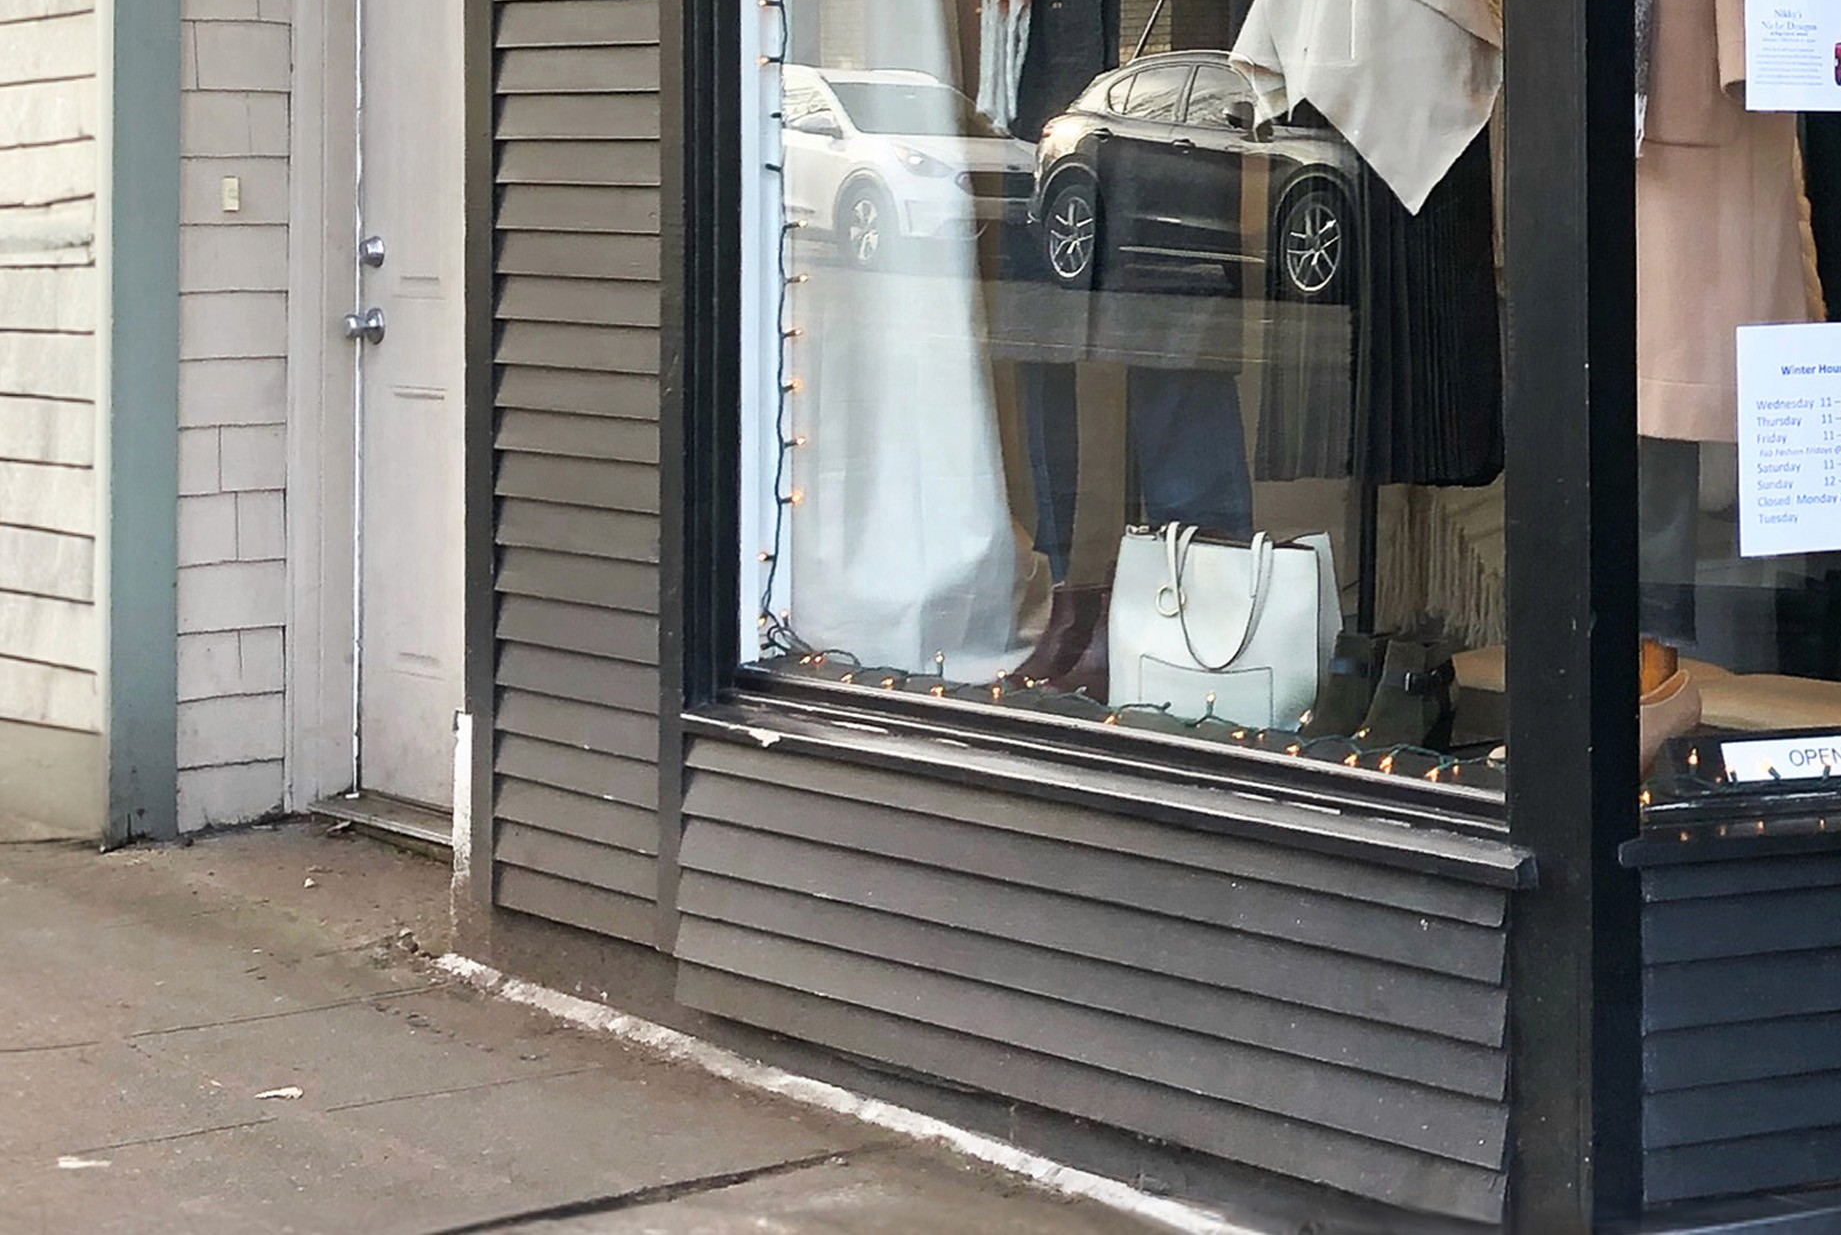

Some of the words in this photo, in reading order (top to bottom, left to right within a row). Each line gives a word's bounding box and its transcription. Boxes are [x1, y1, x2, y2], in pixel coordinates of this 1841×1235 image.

[1781, 366, 1816, 376] Winter
[1756, 398, 1815, 410] Wednesday
[1820, 396, 1832, 407] 11
[1757, 415, 1802, 427] Thursday
[1821, 413, 1833, 424] 11
[1757, 432, 1787, 444] Friday
[1823, 430, 1834, 441] 11
[1757, 461, 1801, 474] Saturday
[1824, 459, 1834, 470] 11
[1757, 479, 1793, 490] Sunday
[1824, 475, 1836, 486] 12
[1796, 494, 1838, 504] Monday
[1759, 513, 1798, 524] Tuesday
